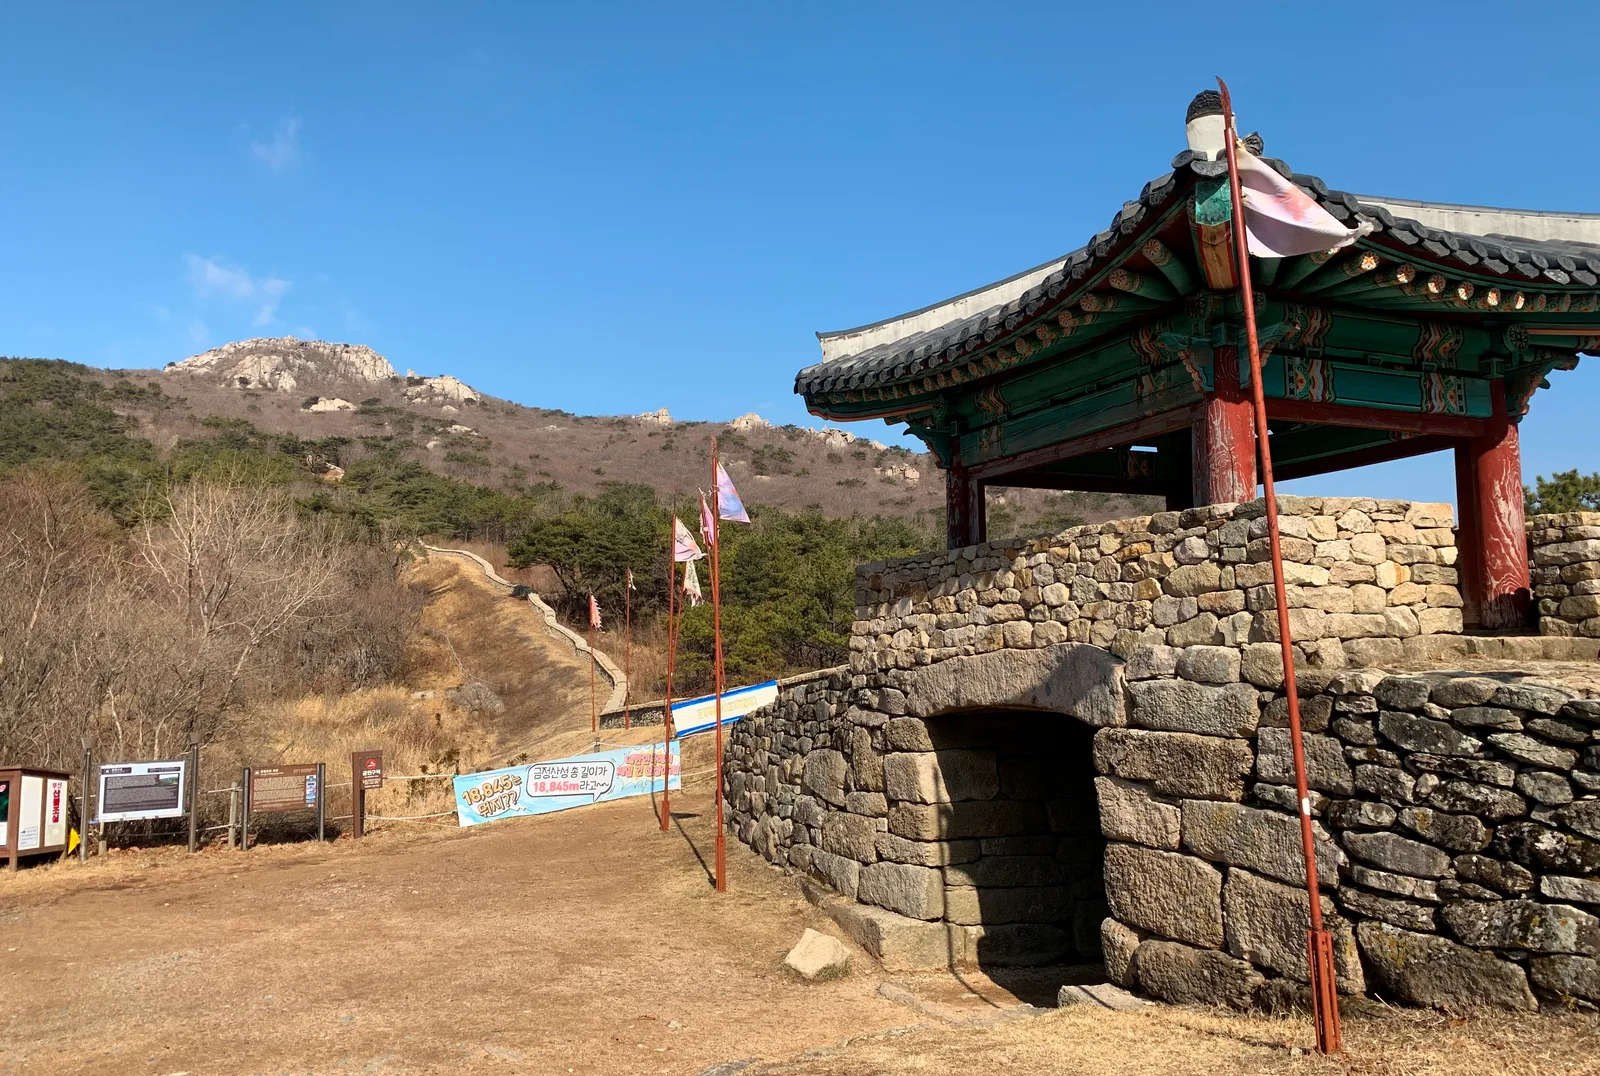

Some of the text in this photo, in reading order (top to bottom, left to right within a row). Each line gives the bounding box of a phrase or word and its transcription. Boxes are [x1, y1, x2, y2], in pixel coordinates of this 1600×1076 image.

[534, 765, 607, 780] 금정산성 총 길이가
[462, 774, 523, 805] 18,845는
